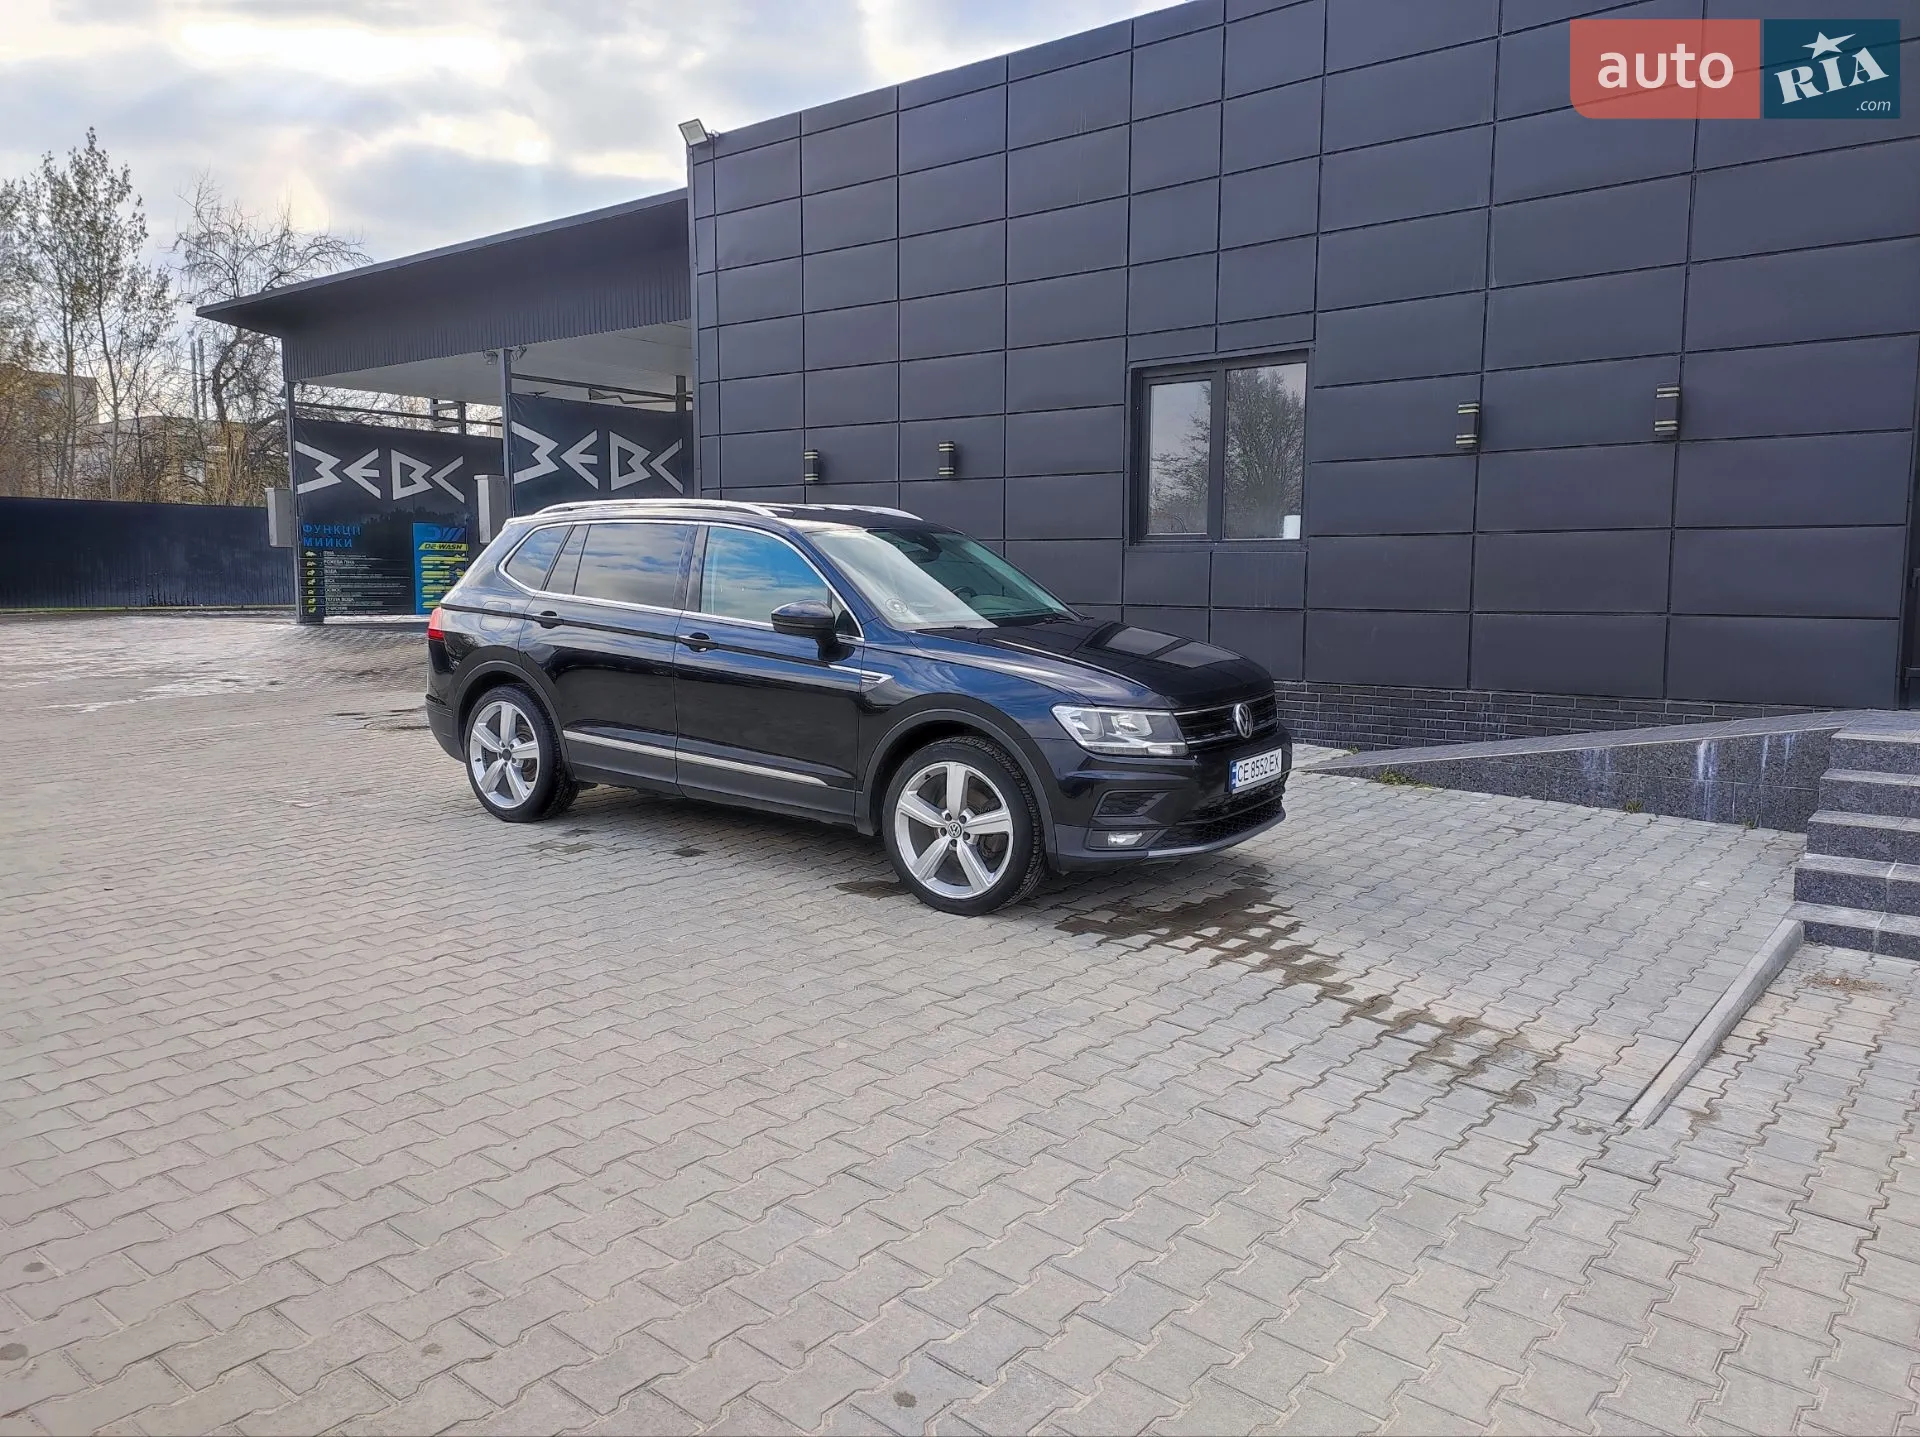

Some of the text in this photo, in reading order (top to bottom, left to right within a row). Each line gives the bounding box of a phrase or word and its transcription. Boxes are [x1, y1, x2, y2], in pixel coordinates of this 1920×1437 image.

[295, 440, 465, 503] ЗЕВС
[511, 420, 684, 495] ЗЕВС
[303, 535, 353, 548] МИЙКИ
[1237, 752, 1280, 782] CE 8552 EX
